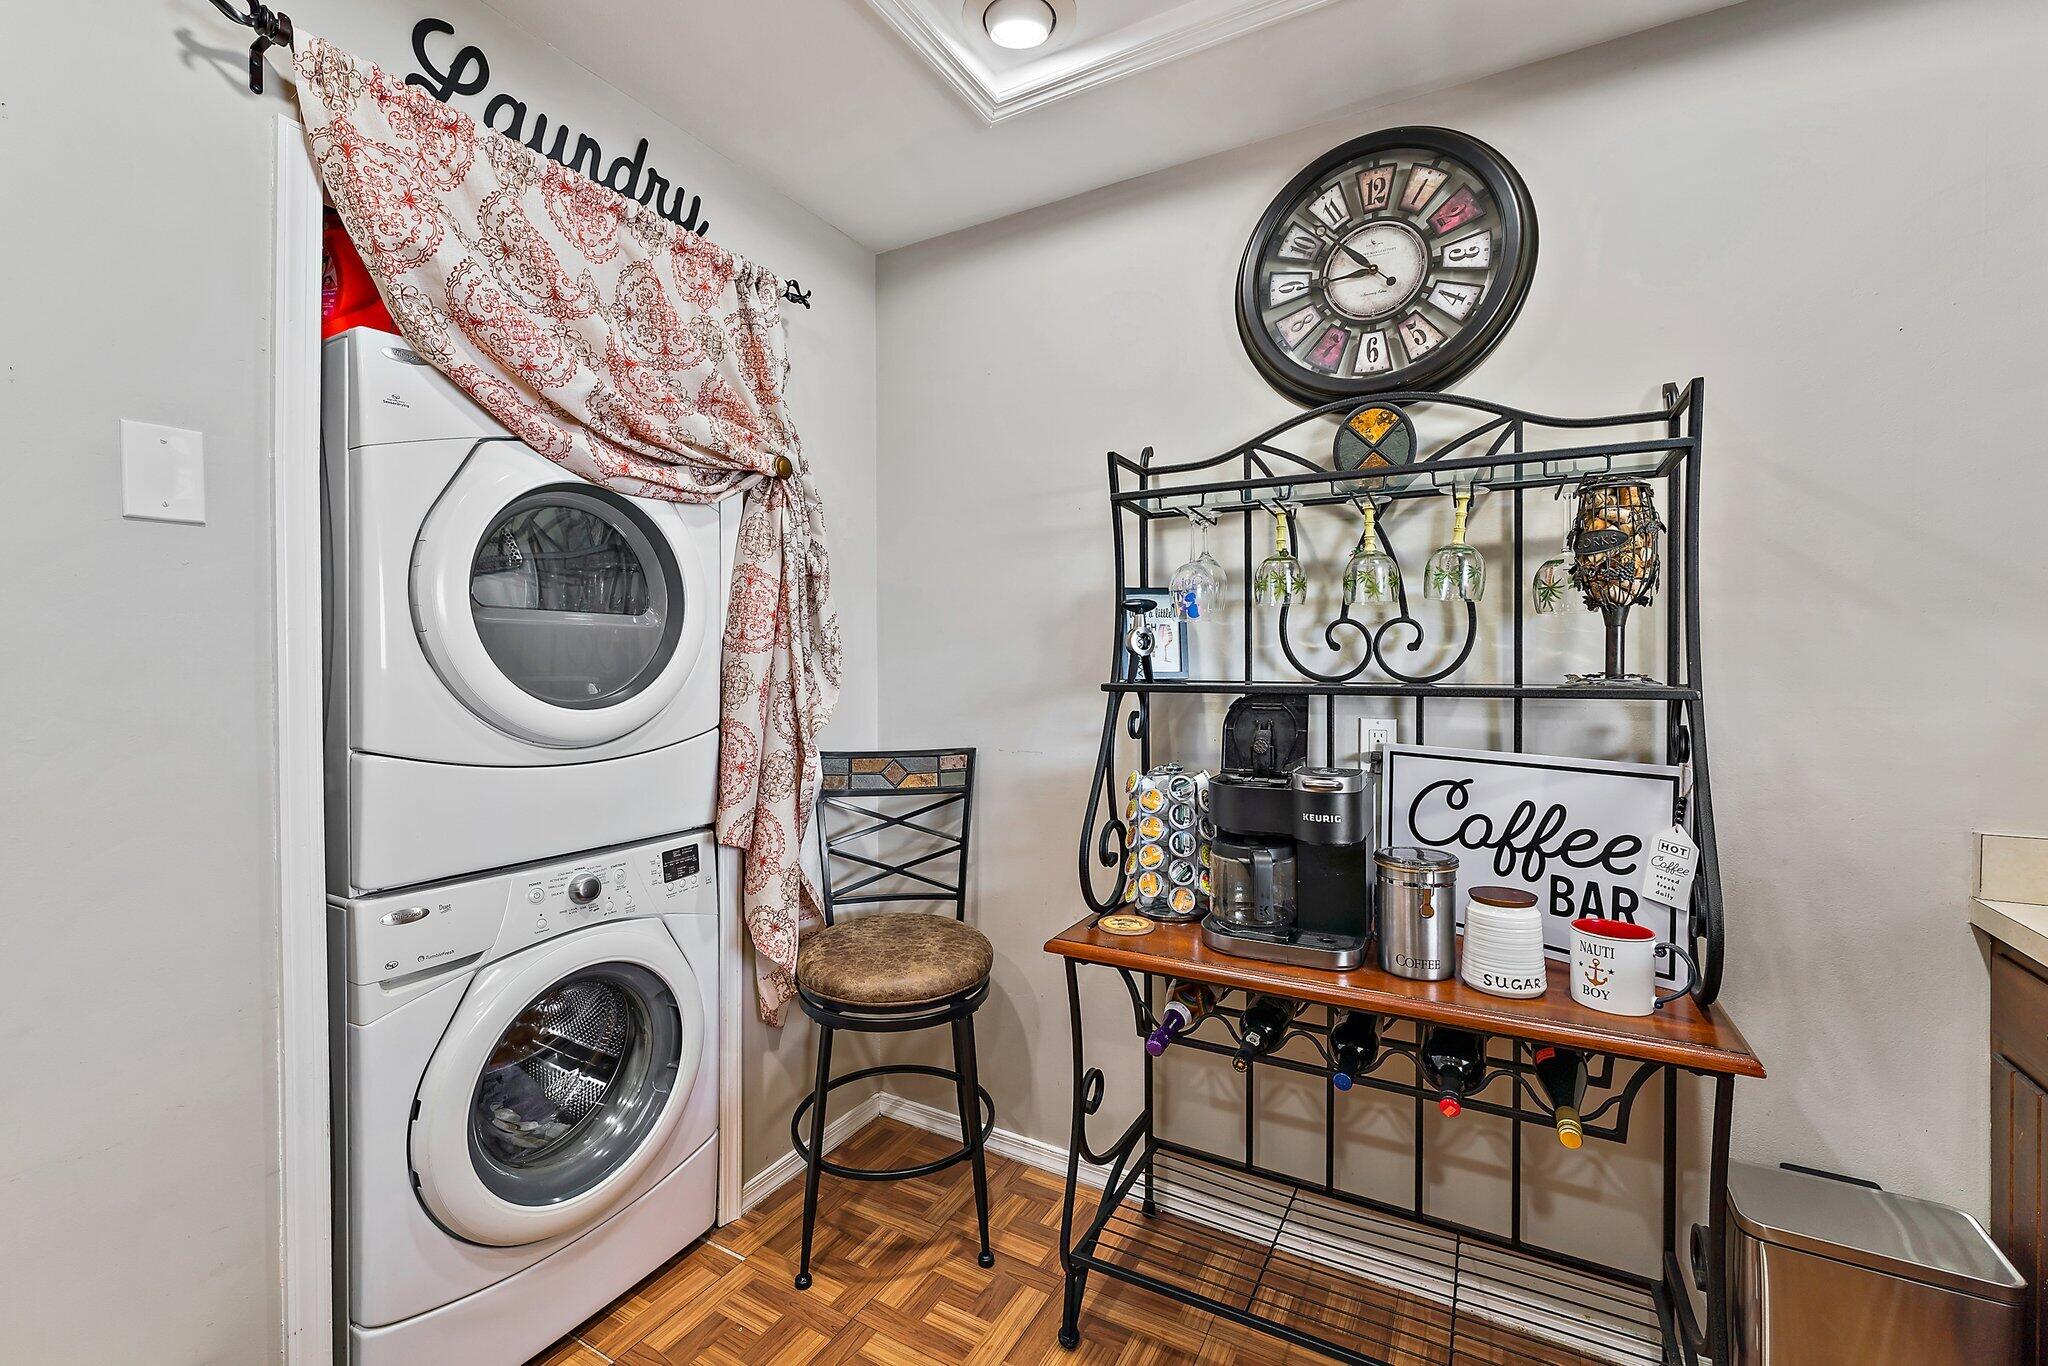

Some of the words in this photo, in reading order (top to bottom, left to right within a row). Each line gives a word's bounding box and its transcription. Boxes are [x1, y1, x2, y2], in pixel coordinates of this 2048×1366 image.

[404, 17, 709, 238] Laundry
[1365, 177, 1386, 207] 12
[1412, 178, 1428, 206] 1
[1322, 199, 1343, 224] 11
[1437, 202, 1464, 229] 2
[1289, 234, 1317, 257] 10
[1448, 245, 1480, 261] 3
[1278, 281, 1305, 294] 9
[1438, 287, 1467, 306] 4
[1291, 313, 1315, 333] 8
[1406, 319, 1427, 346] 5
[1322, 333, 1341, 357] 7
[1367, 336, 1379, 363] 6
[1302, 813, 1342, 823] KEURIG
[1409, 778, 1642, 882] Coffee
[1661, 843, 1687, 856] HOT
[1651, 855, 1689, 876] Coffee
[1656, 874, 1680, 885] served
[1657, 881, 1675, 892] fresh
[1550, 874, 1639, 924] BAR
[1655, 890, 1674, 900] daily
[1579, 940, 1615, 959] NAUTI
[1395, 954, 1441, 970] COFFEE
[1483, 974, 1541, 990] SUGAR
[1582, 984, 1610, 1000] BOY
